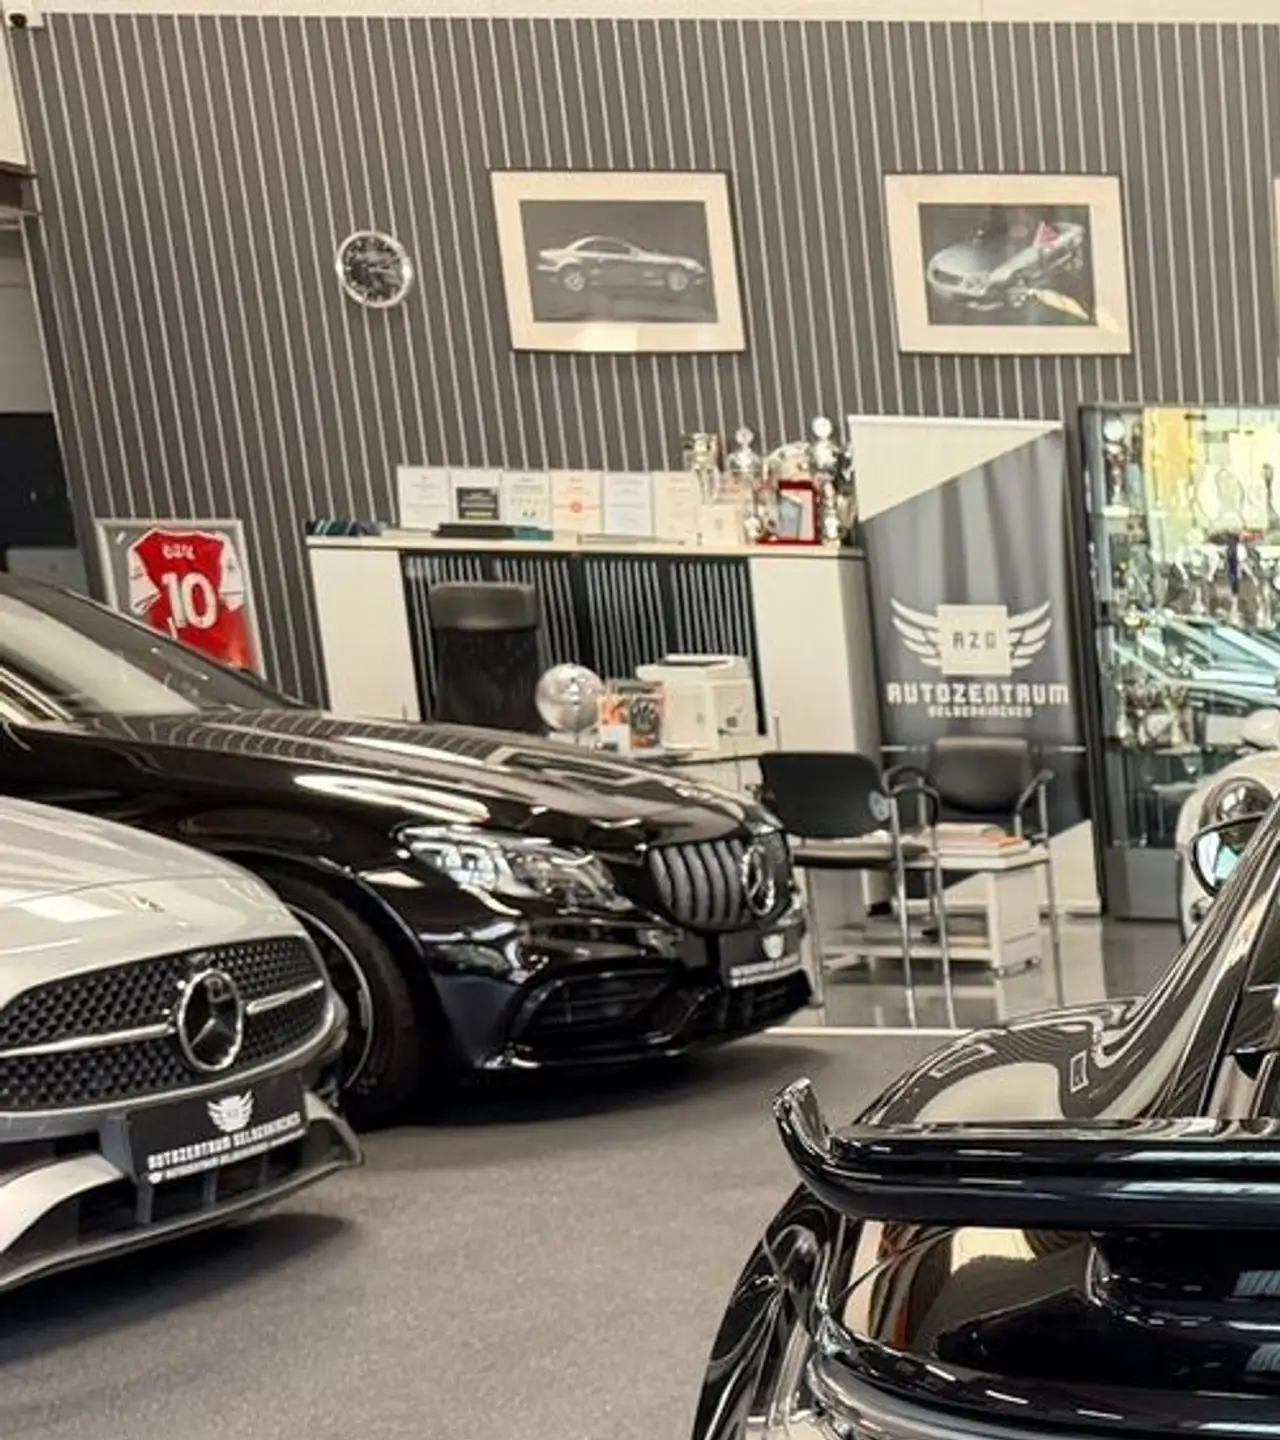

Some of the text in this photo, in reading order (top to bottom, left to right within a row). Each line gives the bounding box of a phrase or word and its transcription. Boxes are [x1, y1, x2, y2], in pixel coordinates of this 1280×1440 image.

[161, 572, 217, 629] 10
[953, 631, 998, 650] AZG
[887, 682, 1069, 705] AUTOZENTRUM
